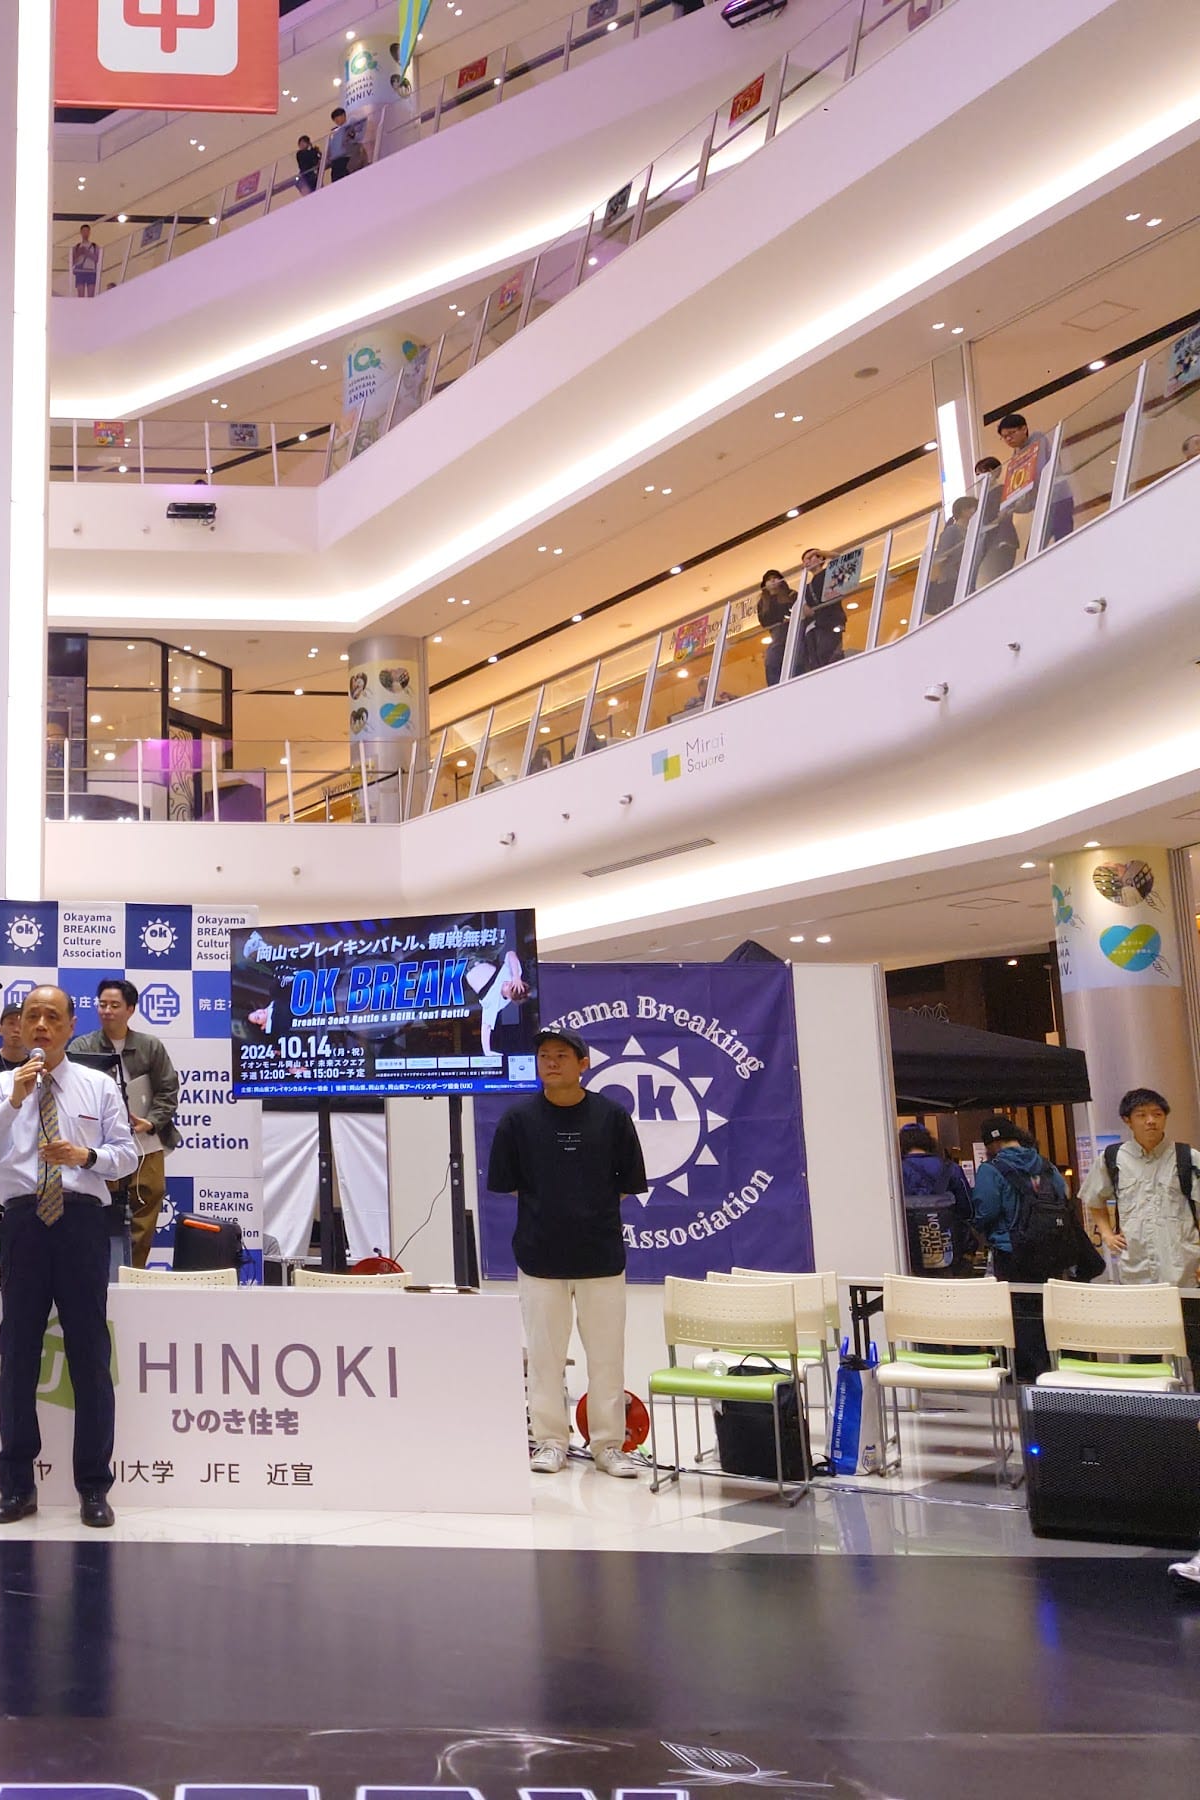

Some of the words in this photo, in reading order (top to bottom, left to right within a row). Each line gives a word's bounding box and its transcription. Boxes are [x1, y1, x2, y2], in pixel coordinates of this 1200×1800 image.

[686, 732, 725, 757] Mirai
[687, 753, 725, 773] Square
[63, 913, 112, 924] Okayama
[197, 915, 246, 927] Okayama
[16, 924, 34, 935] ok
[63, 925, 116, 934] BREAKING
[150, 927, 168, 939] ok
[197, 928, 230, 936] BREAK
[63, 936, 101, 946] Culture
[197, 939, 230, 949] Cultur
[63, 948, 122, 959] Association
[197, 951, 230, 961] Associ
[290, 968, 340, 1016] OK
[347, 957, 469, 1013] BREAK
[636, 995, 764, 1079] Breaking
[240, 1044, 276, 1060] 2024
[278, 1035, 332, 1058] 10.14
[179, 1070, 230, 1086] yama
[180, 1089, 238, 1104] AKING
[174, 1112, 212, 1126] ture
[176, 1134, 249, 1150] ociation
[199, 1189, 249, 1200] Okayama
[199, 1202, 254, 1212] BREAKING
[622, 1168, 775, 1250] Association
[919, 1225, 932, 1254] FACE
[927, 1213, 944, 1254] NORTH
[941, 1229, 952, 1253] THE
[138, 1341, 400, 1399] HINOKI
[171, 1407, 299, 1436] ひのき住宅
[113, 1460, 175, 1485] 川大学
[200, 1463, 240, 1484] JFE
[266, 1463, 314, 1486] 近宣
